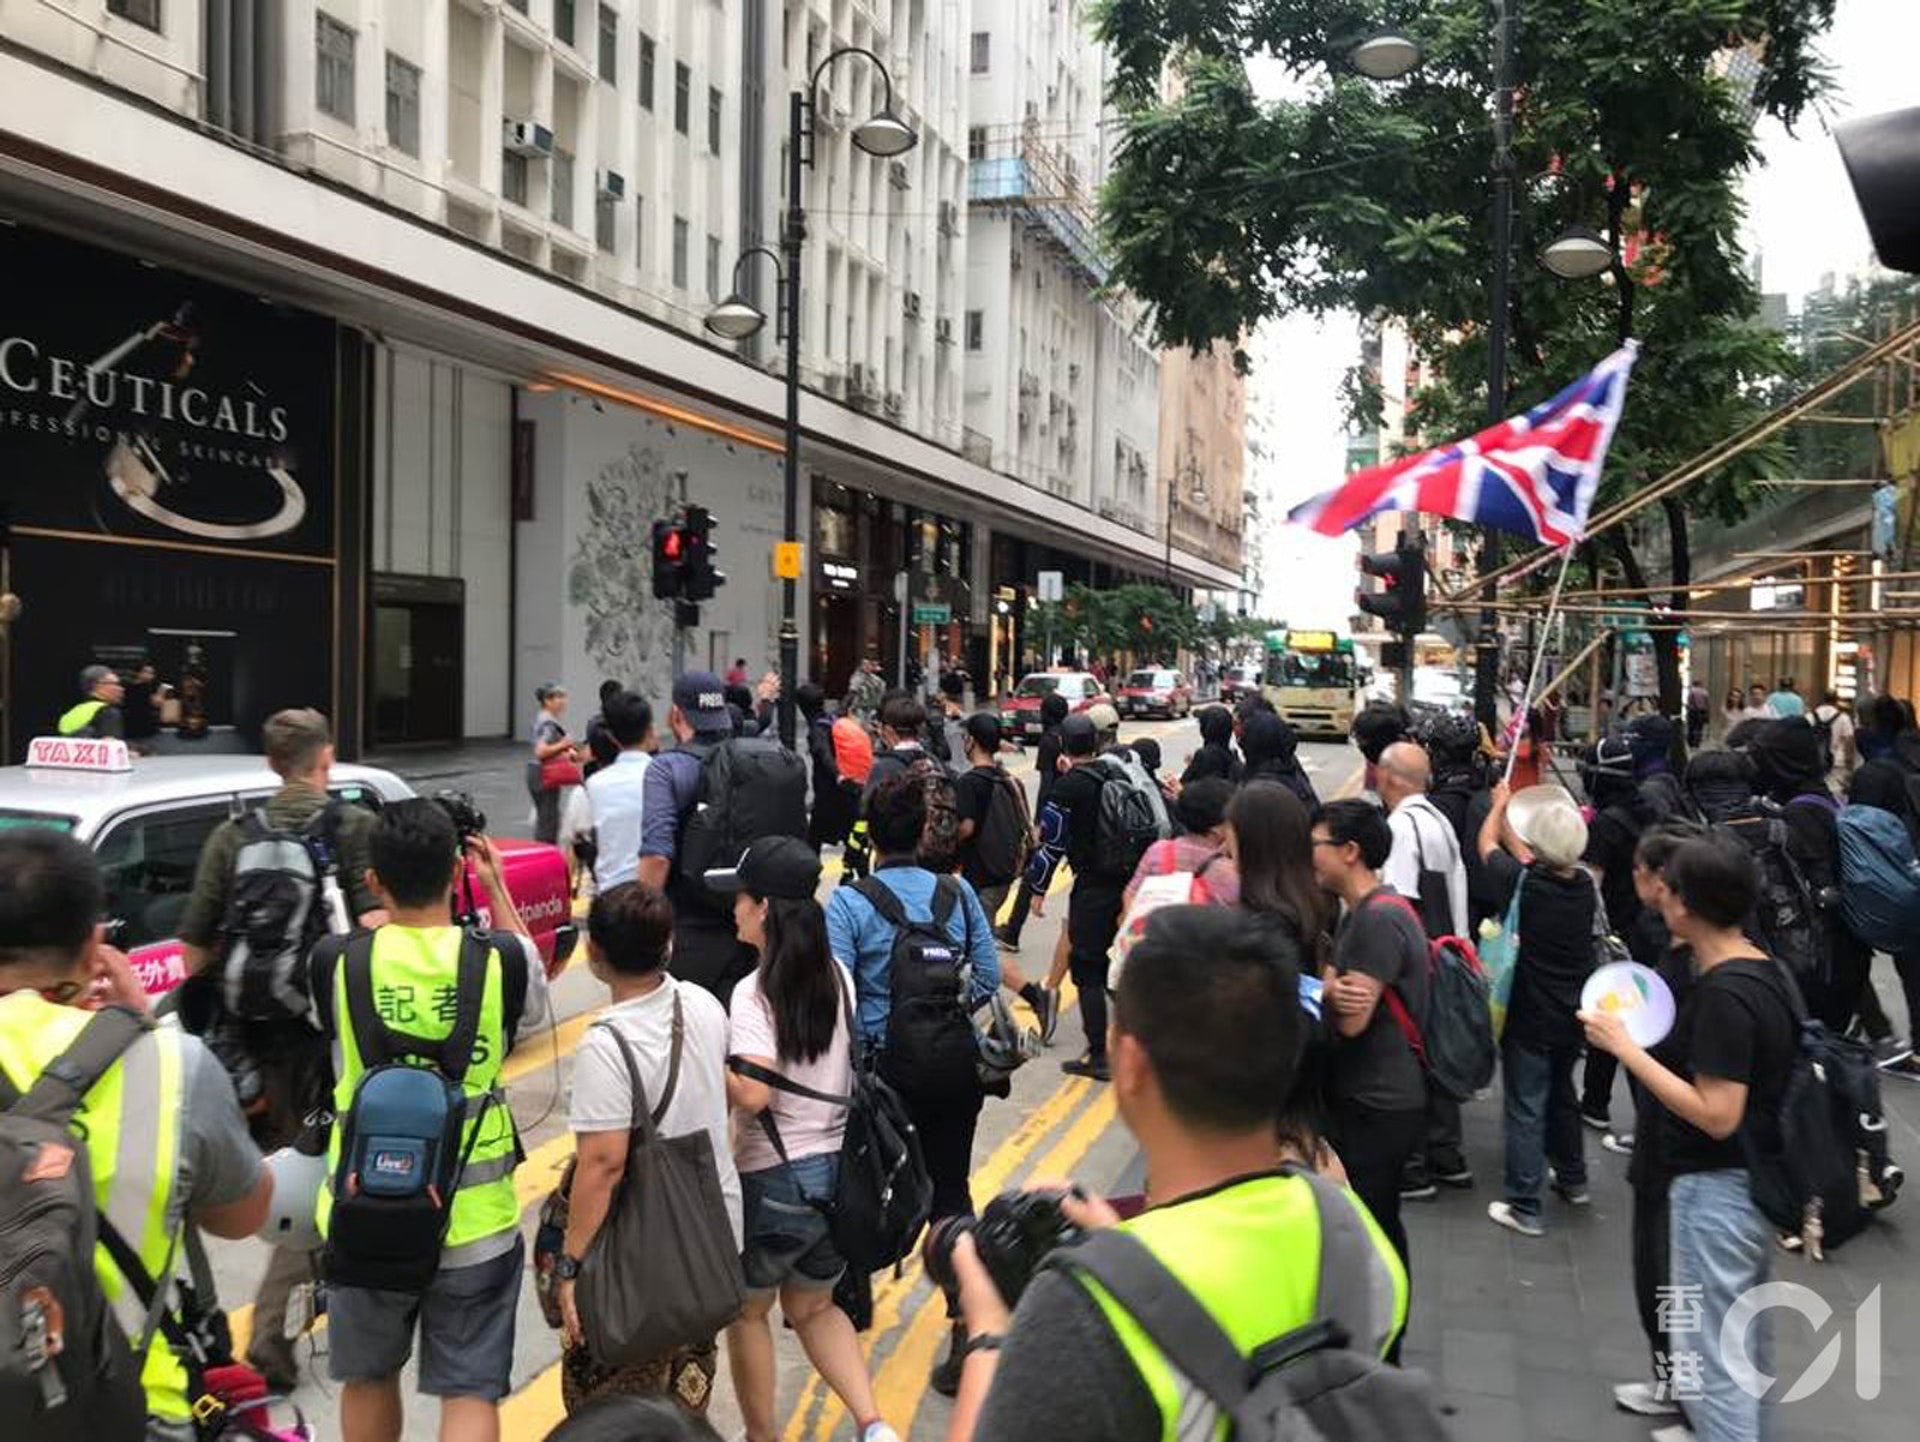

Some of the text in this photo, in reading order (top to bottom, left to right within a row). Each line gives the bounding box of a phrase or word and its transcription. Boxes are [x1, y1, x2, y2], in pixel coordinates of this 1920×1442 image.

[0, 337, 288, 443] CEUTICALS
[34, 741, 108, 765] TAXI
[378, 984, 459, 1022] 記者
